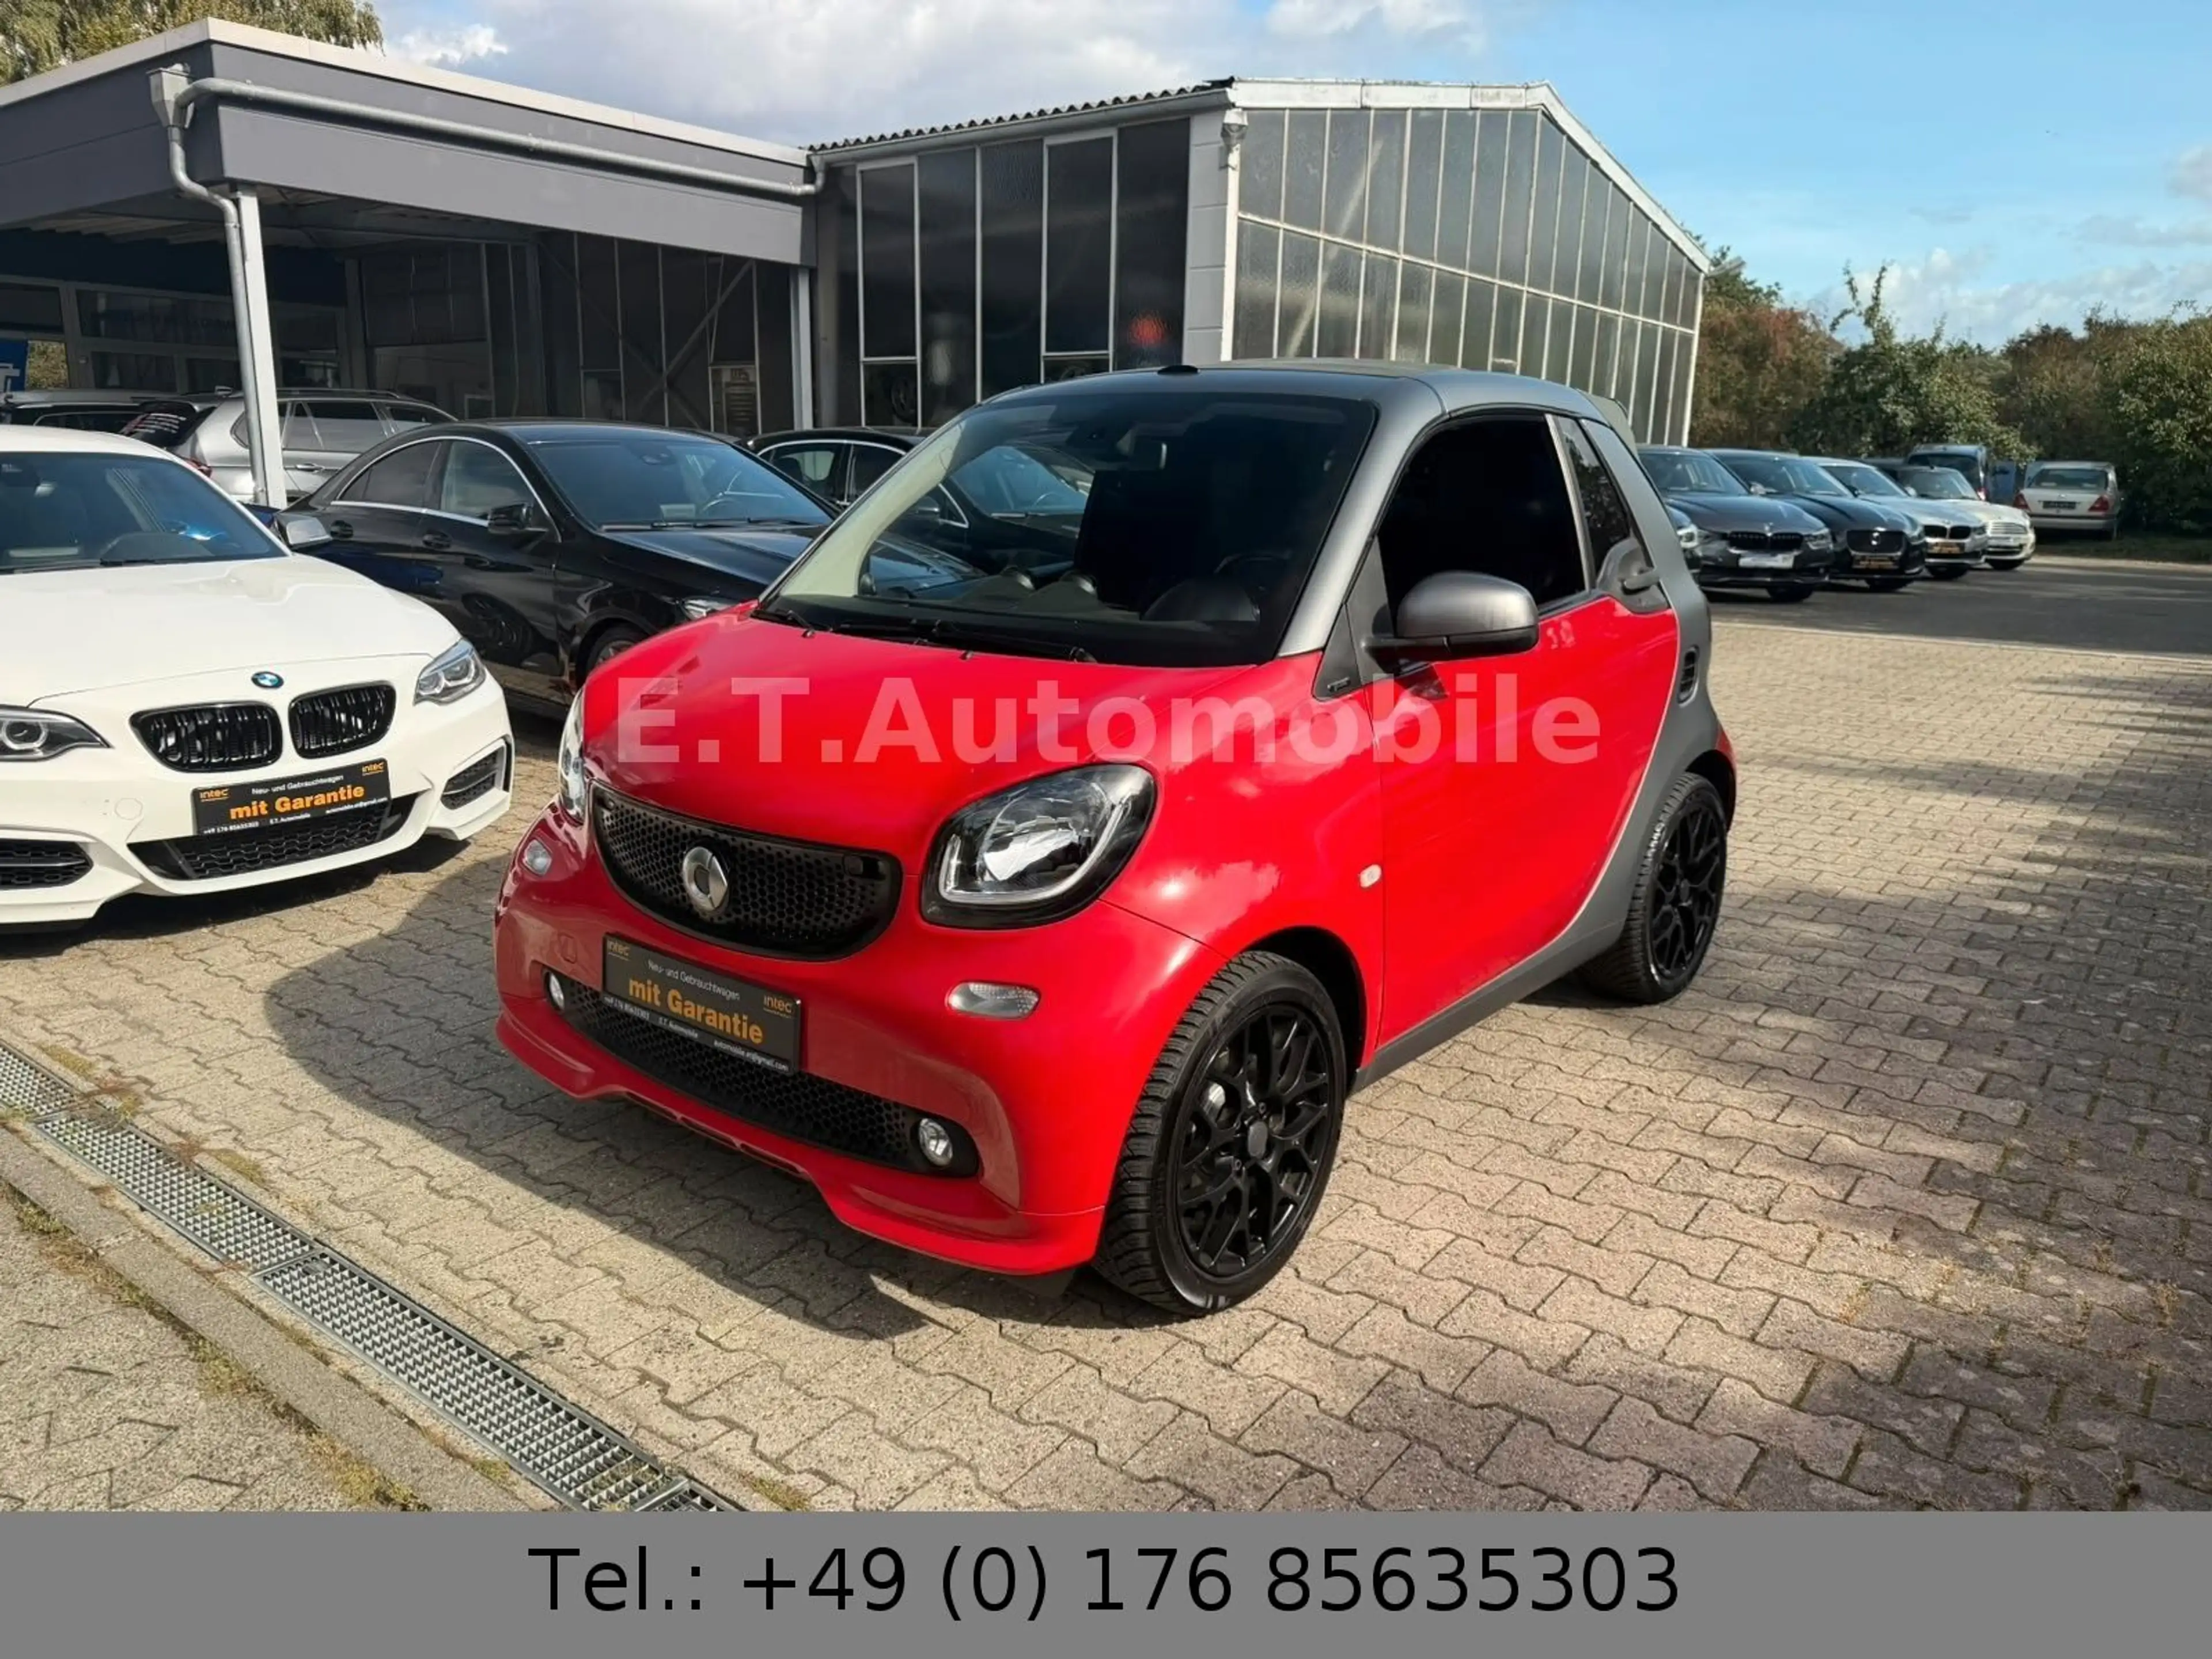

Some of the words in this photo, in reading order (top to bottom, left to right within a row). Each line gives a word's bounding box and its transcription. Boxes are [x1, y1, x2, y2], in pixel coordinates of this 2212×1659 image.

[271, 784, 286, 792] und
[286, 775, 344, 790] Gebrauchtwagen
[230, 798, 268, 819] mit
[275, 784, 365, 812] Garantie
[665, 968, 679, 979] und
[680, 971, 740, 1001] Gebrauchtwagen
[629, 978, 661, 1007] mit
[667, 988, 763, 1044] Garantie
[763, 995, 791, 1013] intec
